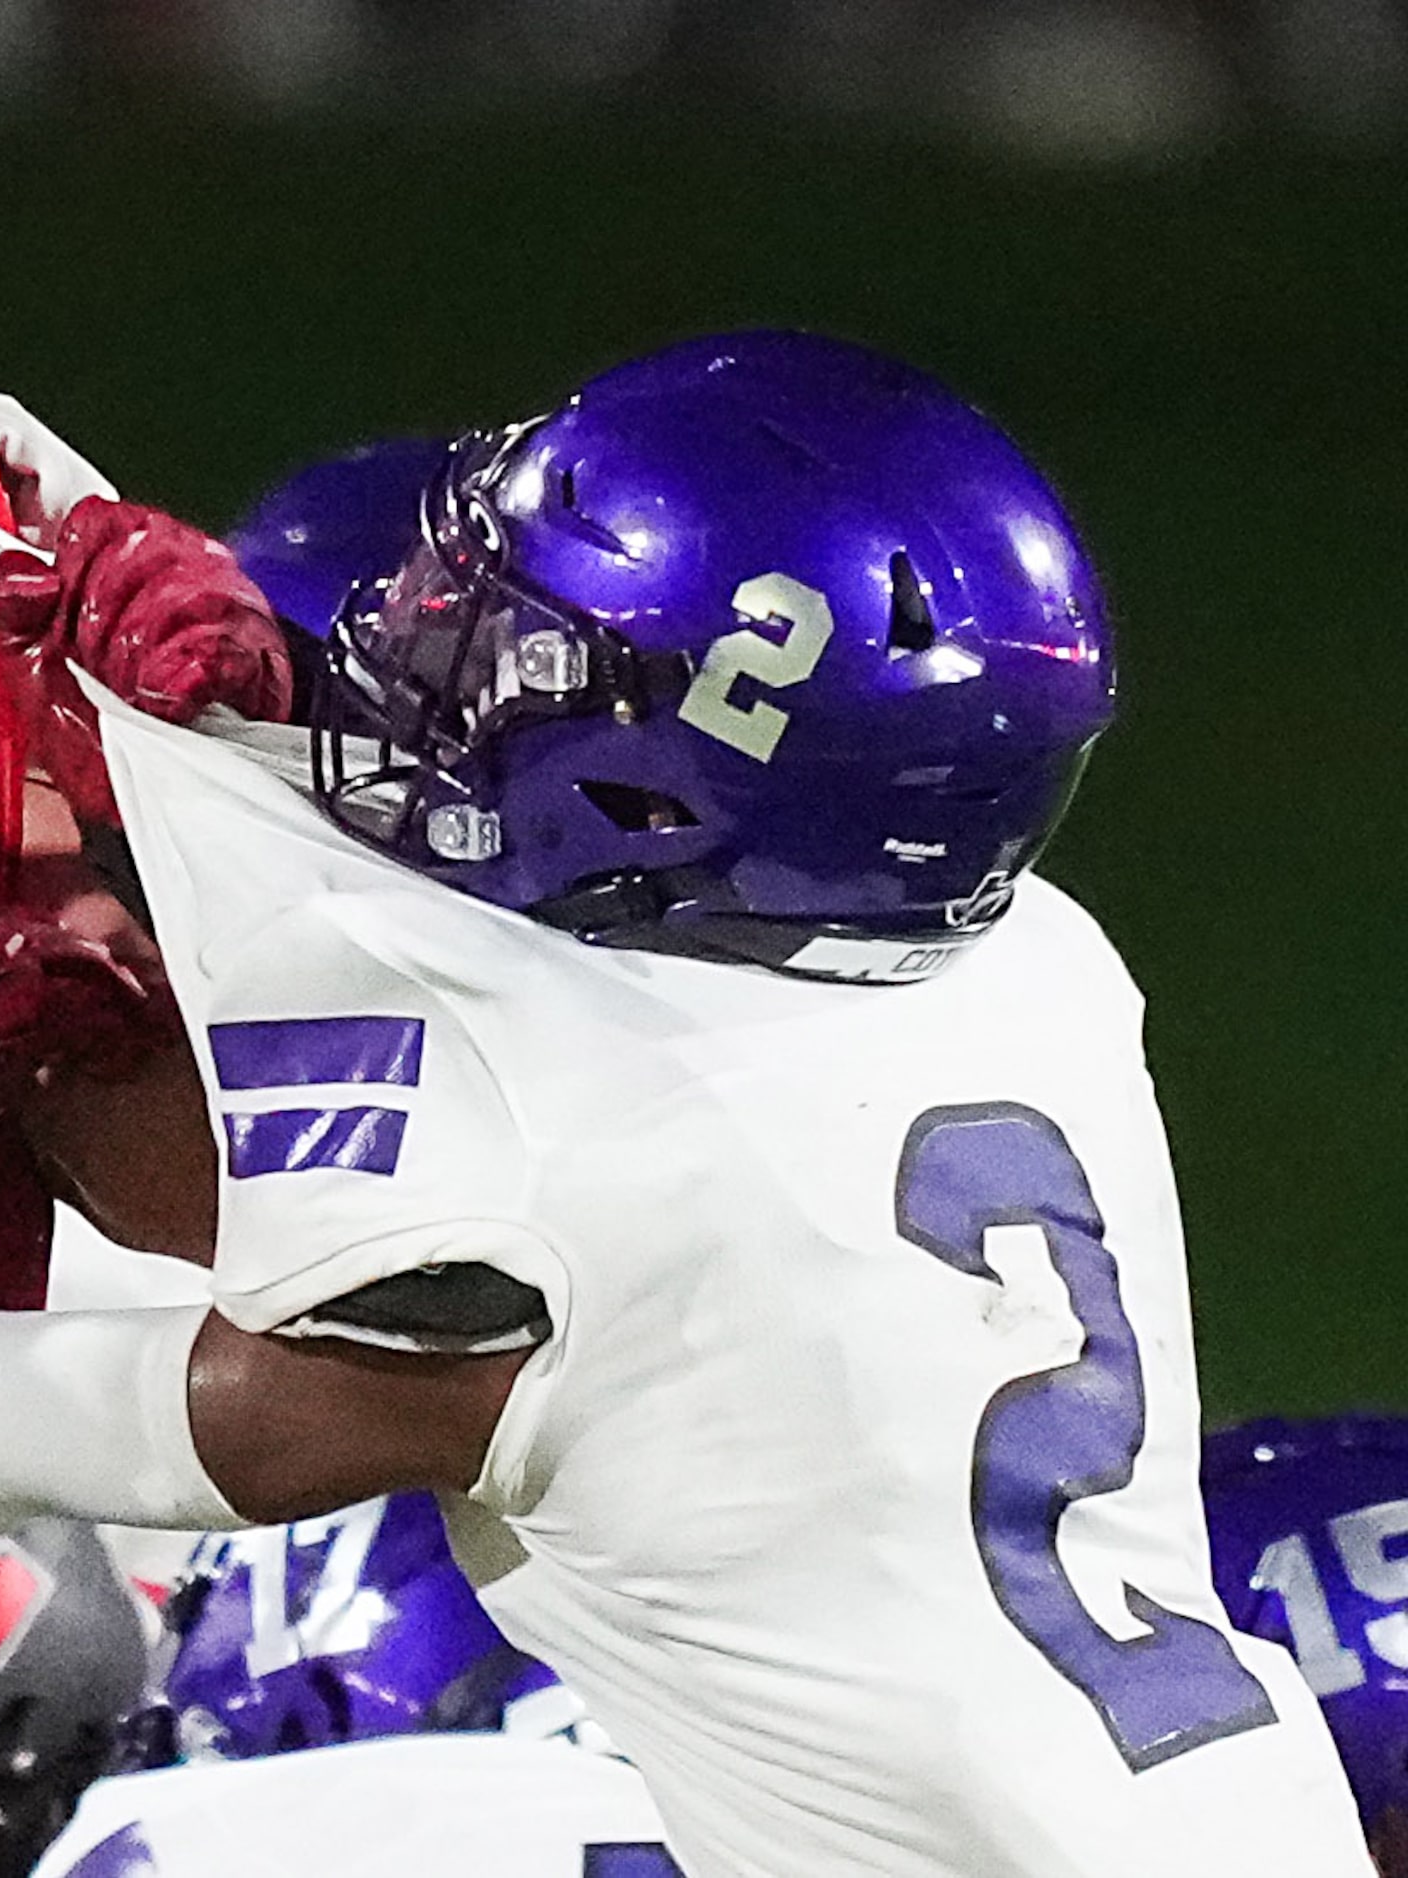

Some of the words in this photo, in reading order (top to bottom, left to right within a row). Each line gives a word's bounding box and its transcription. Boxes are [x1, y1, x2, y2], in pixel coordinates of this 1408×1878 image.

[677, 571, 835, 764] 2
[895, 1099, 1280, 1776] 2
[226, 1494, 392, 1680] 17
[1248, 1497, 1408, 1697] 15
